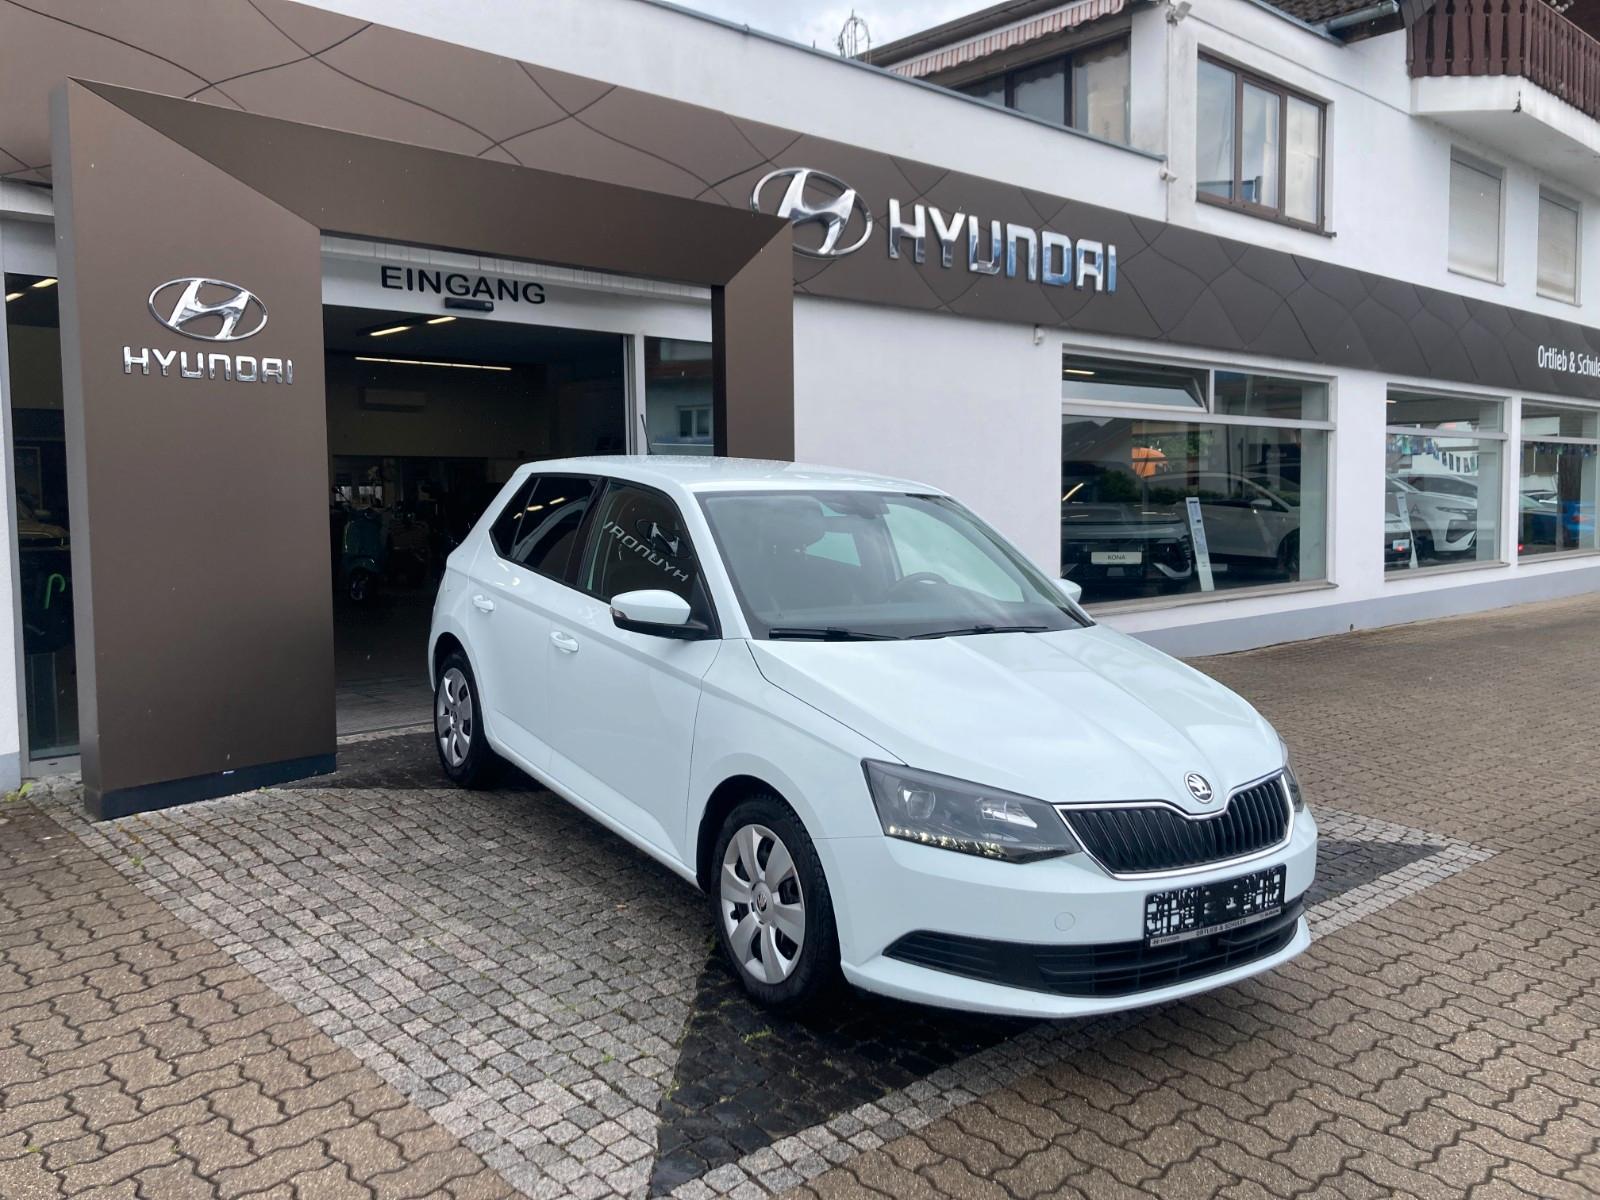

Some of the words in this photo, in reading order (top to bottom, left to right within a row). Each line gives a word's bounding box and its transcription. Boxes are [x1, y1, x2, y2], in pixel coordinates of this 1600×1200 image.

[888, 198, 1117, 294] HYUNDAI
[381, 265, 546, 305] EINGANG
[123, 346, 293, 385] HYUNDAI
[1538, 345, 1567, 371] Ortlieb
[1569, 351, 1576, 373] &
